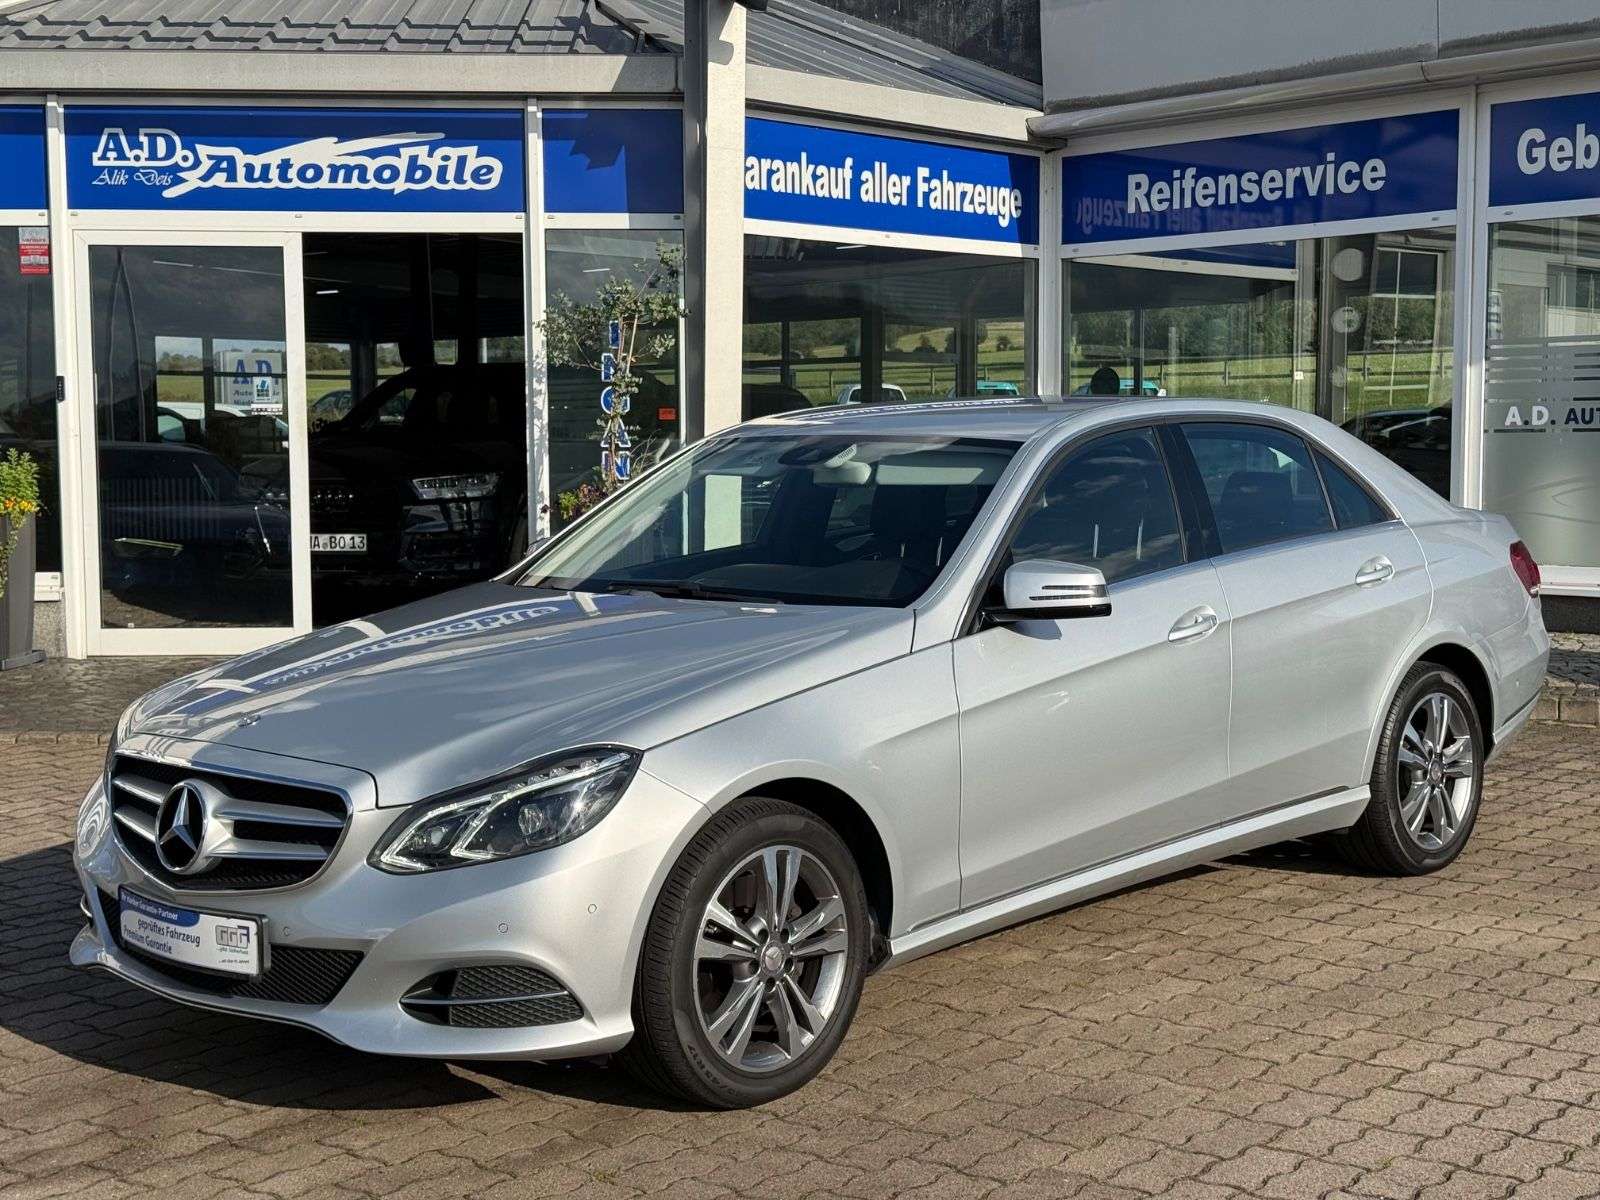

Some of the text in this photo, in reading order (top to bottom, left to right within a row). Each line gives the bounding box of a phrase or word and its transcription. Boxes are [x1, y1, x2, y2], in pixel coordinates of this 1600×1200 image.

[92, 128, 502, 191] A.D. Automobile
[1517, 123, 1600, 175] Geb
[92, 168, 174, 187] Alik Deis
[860, 160, 911, 206] aller
[916, 166, 1022, 228] Fahrzeuge
[1127, 152, 1387, 214] Reifenservice
[1504, 405, 1556, 427] A.D.
[138, 917, 201, 947] geprüftes Fahrzeug
[145, 935, 173, 954] Garantie
